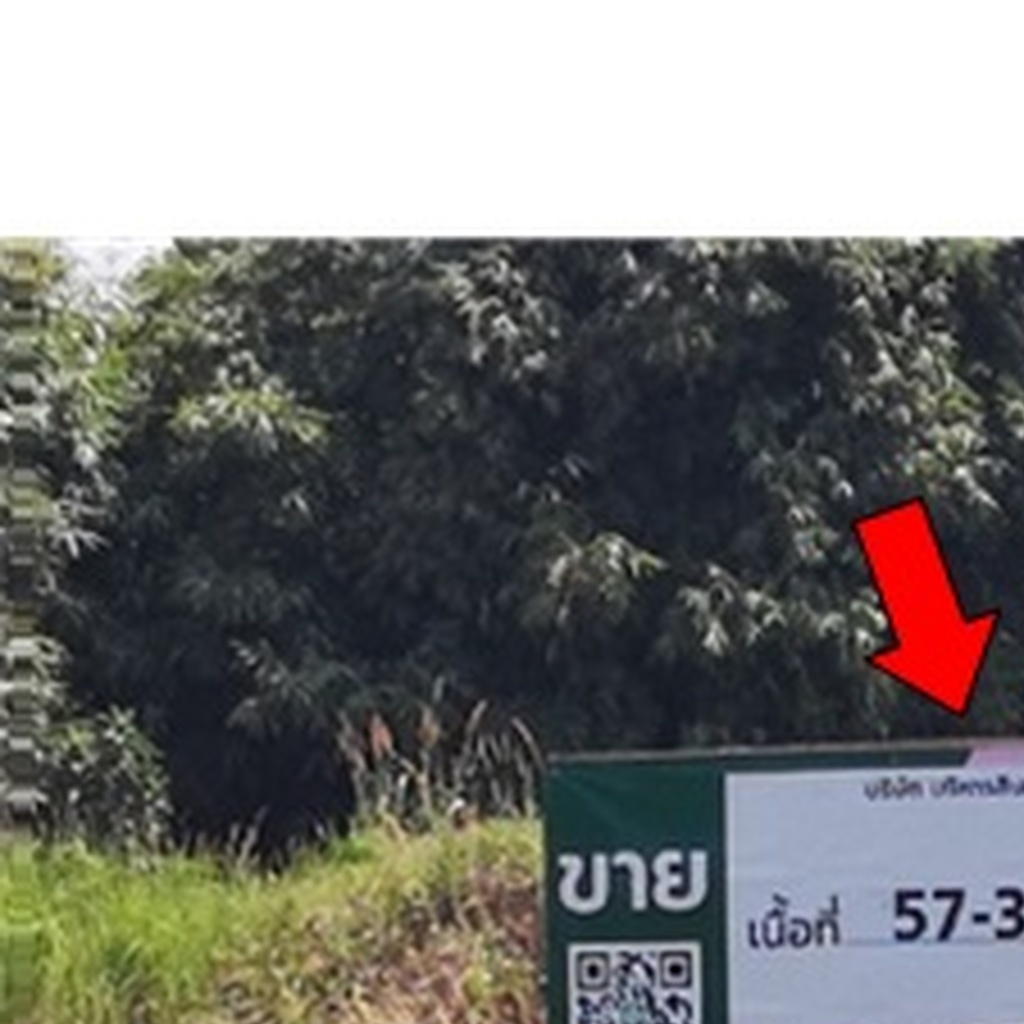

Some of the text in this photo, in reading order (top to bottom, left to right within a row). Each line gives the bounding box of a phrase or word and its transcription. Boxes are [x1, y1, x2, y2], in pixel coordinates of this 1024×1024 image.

[557, 846, 708, 914] ขาย
[747, 893, 841, 950] เนื้อที่
